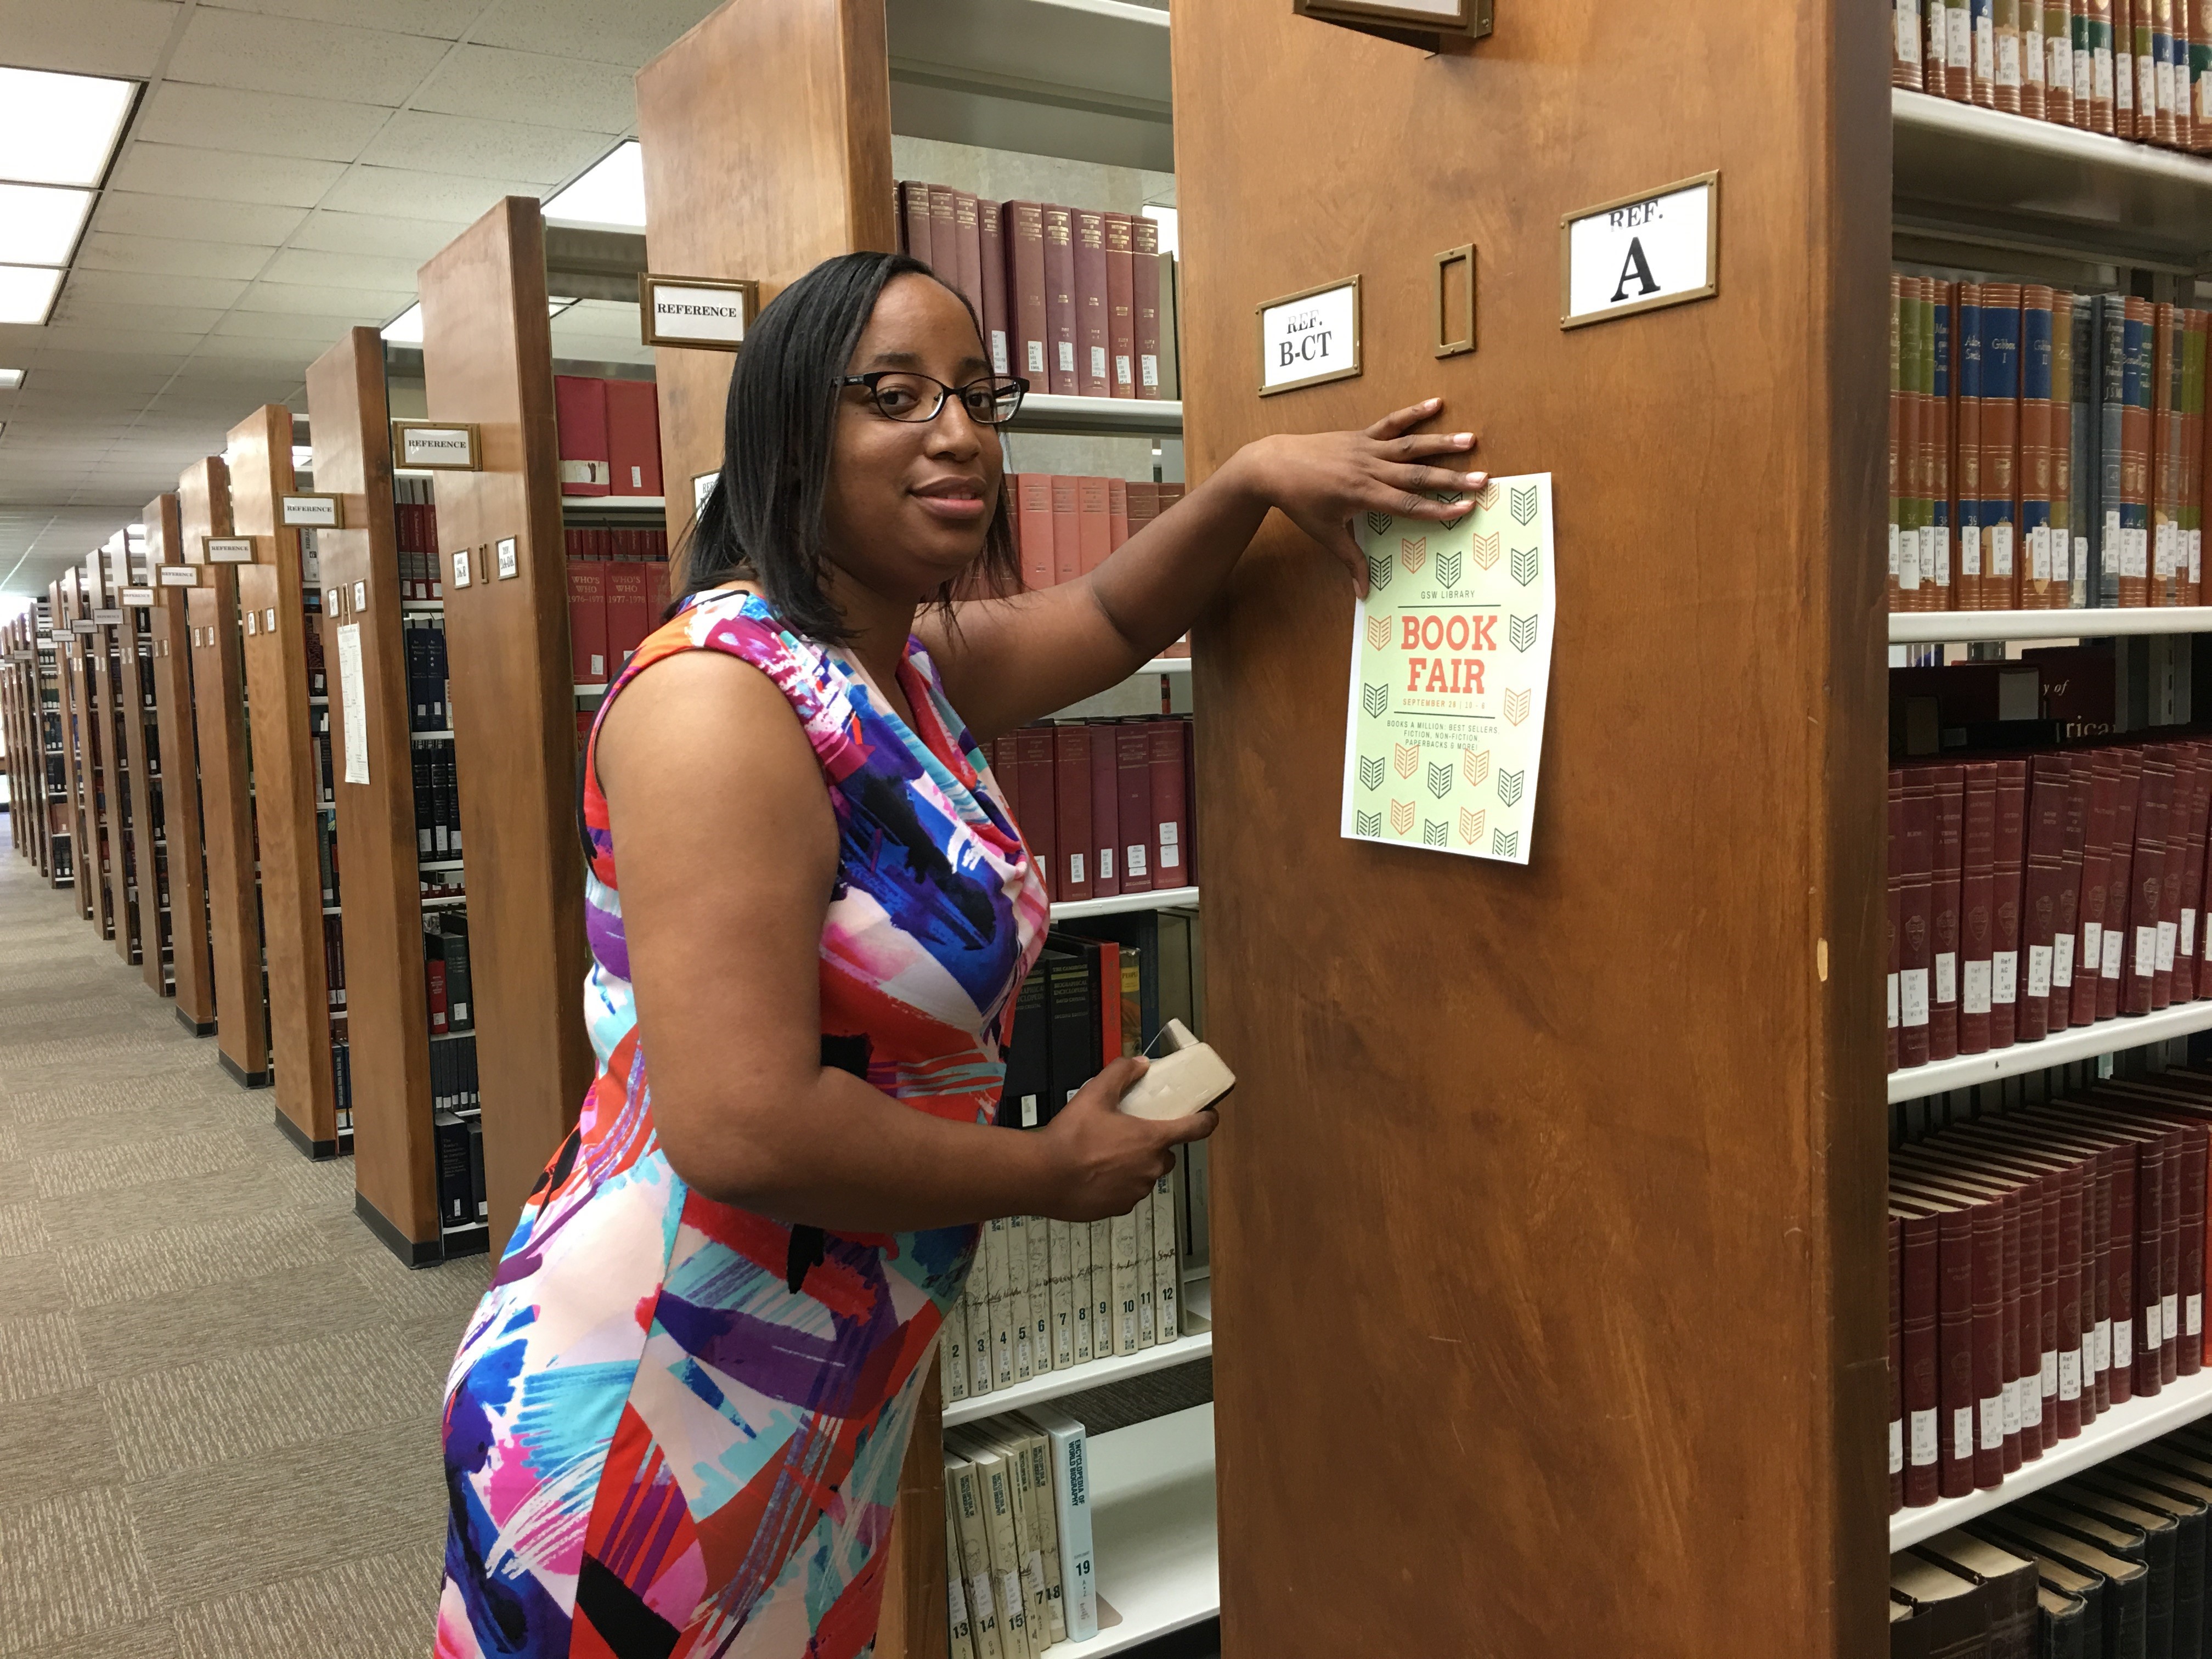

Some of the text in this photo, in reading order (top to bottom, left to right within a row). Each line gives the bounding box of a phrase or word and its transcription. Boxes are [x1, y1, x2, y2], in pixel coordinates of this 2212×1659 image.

[1982, 5, 1988, 15] 6
[2033, 20, 2038, 31] 8
[2162, 48, 2169, 58] 14
[1609, 198, 1663, 232] REF.
[1610, 236, 1661, 302] A
[657, 303, 737, 317] REFERENCE
[1286, 309, 1322, 334] REF.
[1279, 331, 1332, 367] B-CT
[2002, 353, 2006, 363] I
[408, 439, 466, 448] REFERENCE
[1968, 515, 1977, 526] 39
[571, 576, 600, 584] WHO'S
[1441, 590, 1475, 599] LIBRARY
[1401, 615, 1497, 651] BOOK
[1407, 657, 1485, 694] FAIR
[2044, 679, 2069, 696] y of
[1403, 698, 1445, 707] SEPTEMBER
[1387, 720, 1408, 728] BOOKS
[1417, 722, 1446, 730] MILLION:
[1404, 730, 1432, 739] FICTION,
[1405, 739, 1447, 749] PAPERBACKS
[1054, 980, 1087, 988] BIOGRAPHICAL
[1054, 987, 1088, 995] ENCYCLOPEDIA
[1141, 1291, 1150, 1305] 11
[1163, 1288, 1173, 1301] 12
[1100, 1301, 1106, 1314] 9
[1123, 1300, 1134, 1313] 10
[1059, 1312, 1066, 1325] 7
[1079, 1308, 1085, 1320] 8
[1038, 1319, 1045, 1332] 6
[1000, 1331, 1007, 1344] 4
[1019, 1327, 1026, 1339] 5
[952, 1345, 959, 1358] 2
[978, 1339, 984, 1352] 3
[1075, 1439, 1085, 1504] ENCYCLOPEDIA OF
[1070, 1466, 1079, 1506] BIOGRAPHY
[1076, 1560, 1090, 1576] 19
[1045, 1584, 1060, 1600] 18
[980, 1616, 995, 1633] 14
[1009, 1613, 1023, 1630] 15
[953, 1622, 968, 1639] 13
